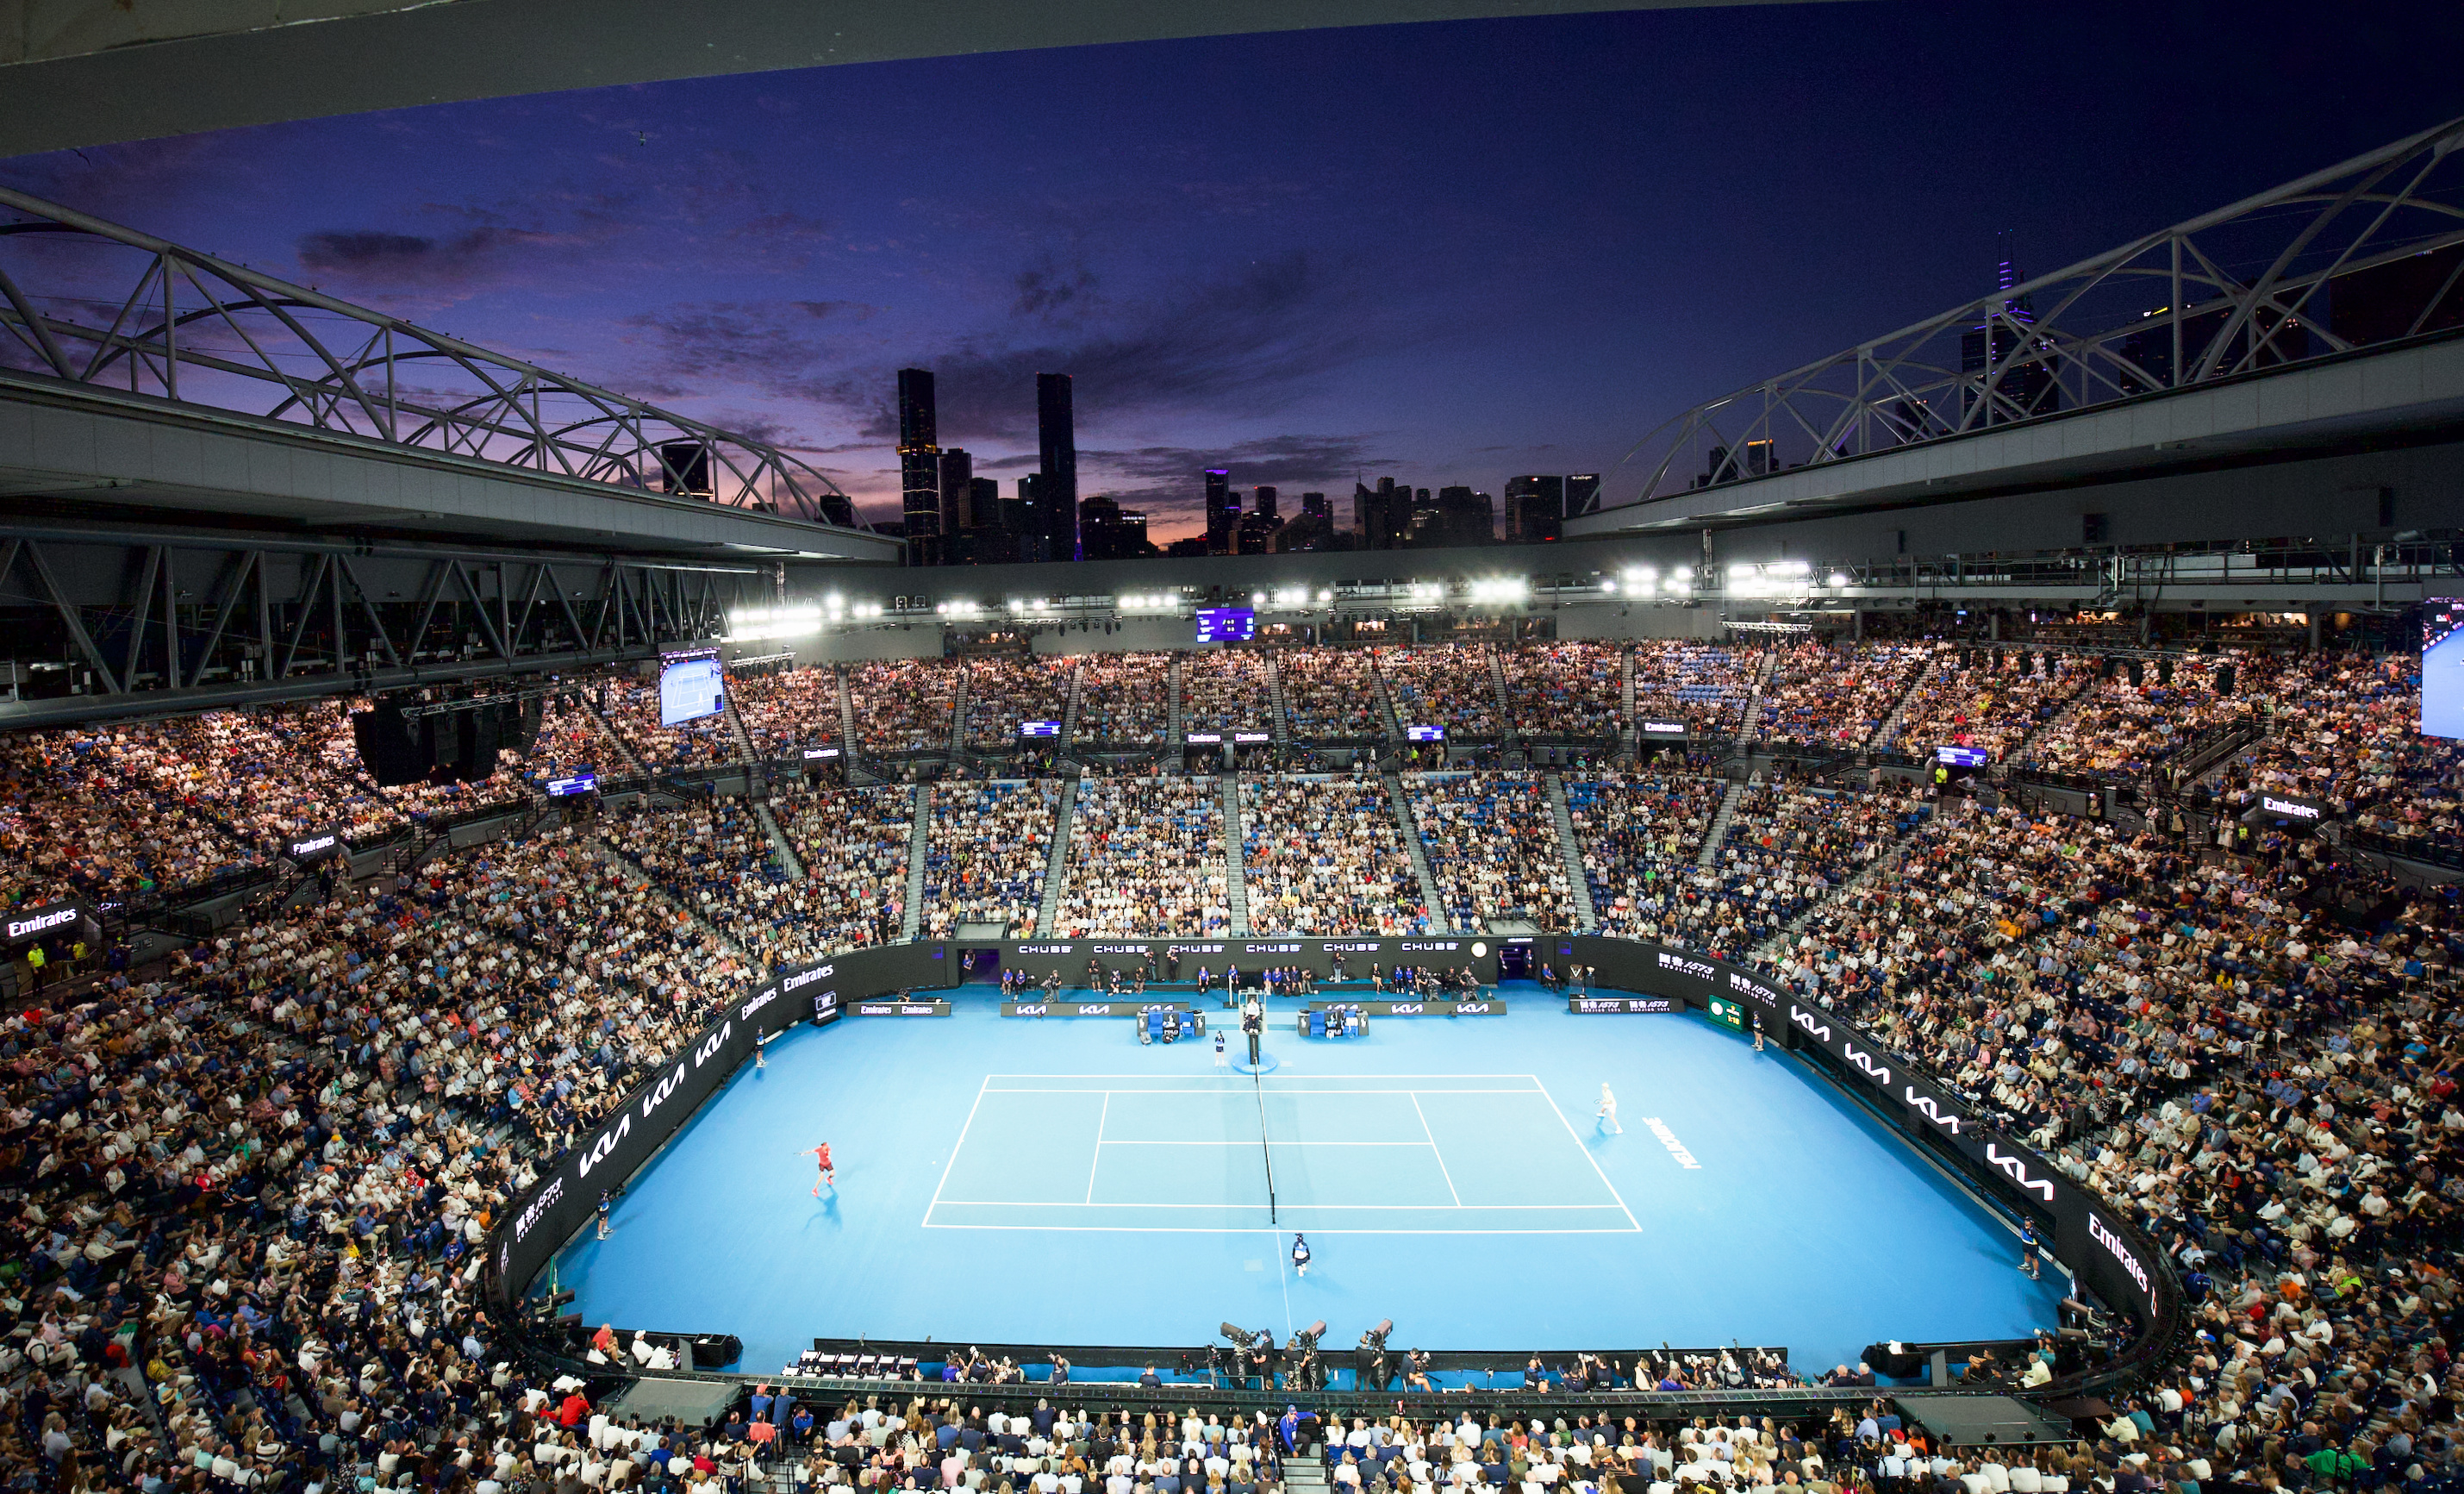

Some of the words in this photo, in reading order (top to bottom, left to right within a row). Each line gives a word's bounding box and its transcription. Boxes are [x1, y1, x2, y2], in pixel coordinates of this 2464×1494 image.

[1645, 722, 1683, 732] Emirates
[1188, 734, 1220, 742] Emirates
[1236, 733, 1268, 741] Emirates
[804, 749, 839, 759] Emirates
[2263, 797, 2319, 819] Emirates
[293, 835, 335, 856] Emirates
[8, 908, 77, 937] Emirates
[1018, 945, 1072, 953] CHUBB
[1093, 945, 1149, 953] CHUBB
[1245, 944, 1302, 953] CHUBB
[1401, 942, 1459, 951] CHUBB
[783, 965, 833, 992] Emirates
[741, 988, 777, 1022] Emirates
[860, 1005, 892, 1015] Emirates
[901, 1005, 933, 1015] Emirates
[2089, 1213, 2149, 1292] Emirates
